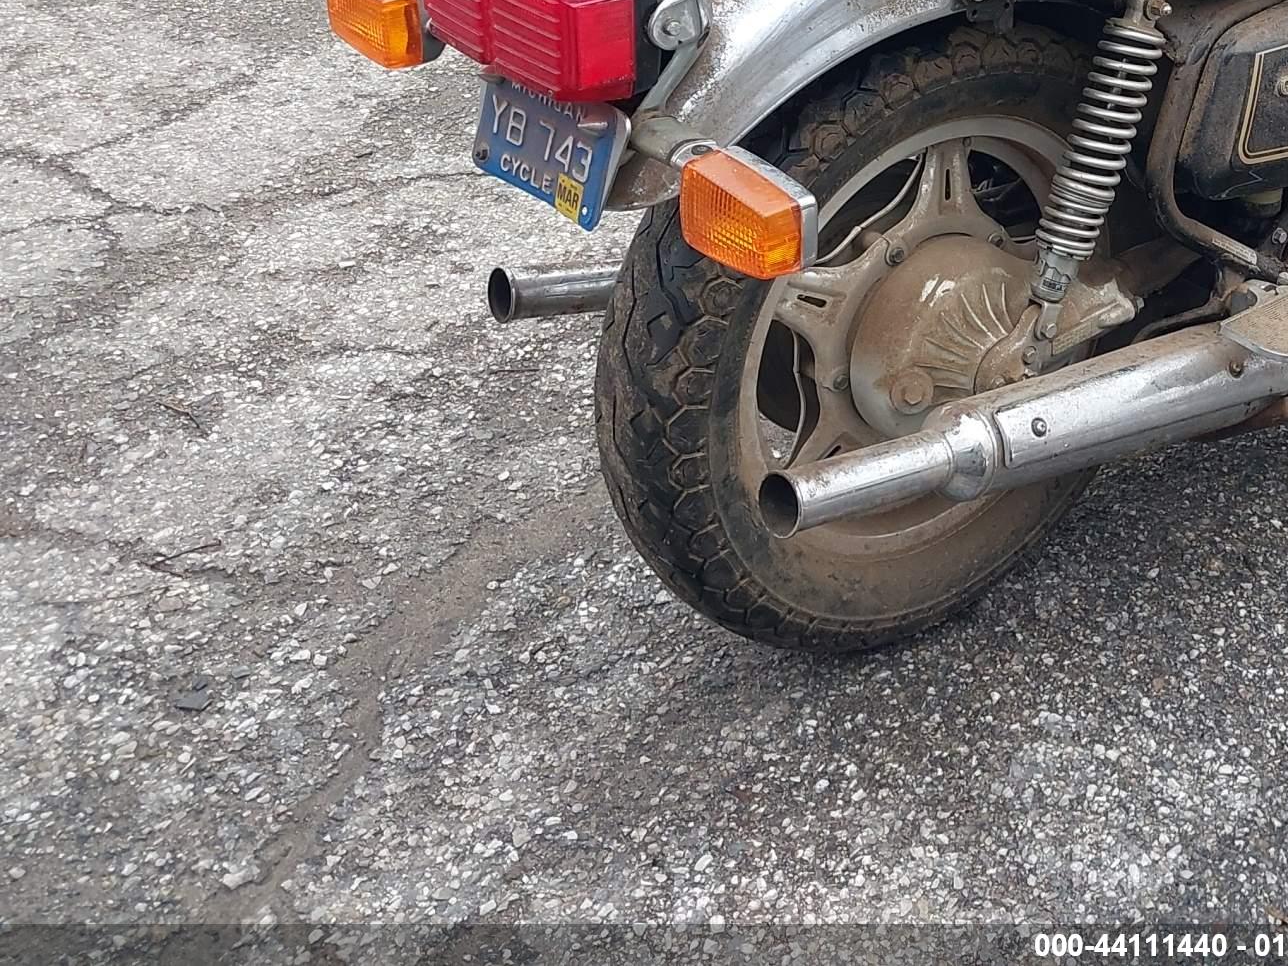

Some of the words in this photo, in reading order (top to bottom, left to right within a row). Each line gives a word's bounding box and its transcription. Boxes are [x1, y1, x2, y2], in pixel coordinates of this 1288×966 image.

[492, 94, 527, 147] YB
[538, 119, 593, 184] 743
[500, 153, 554, 194] CYCLE
[557, 183, 580, 211] MAR
